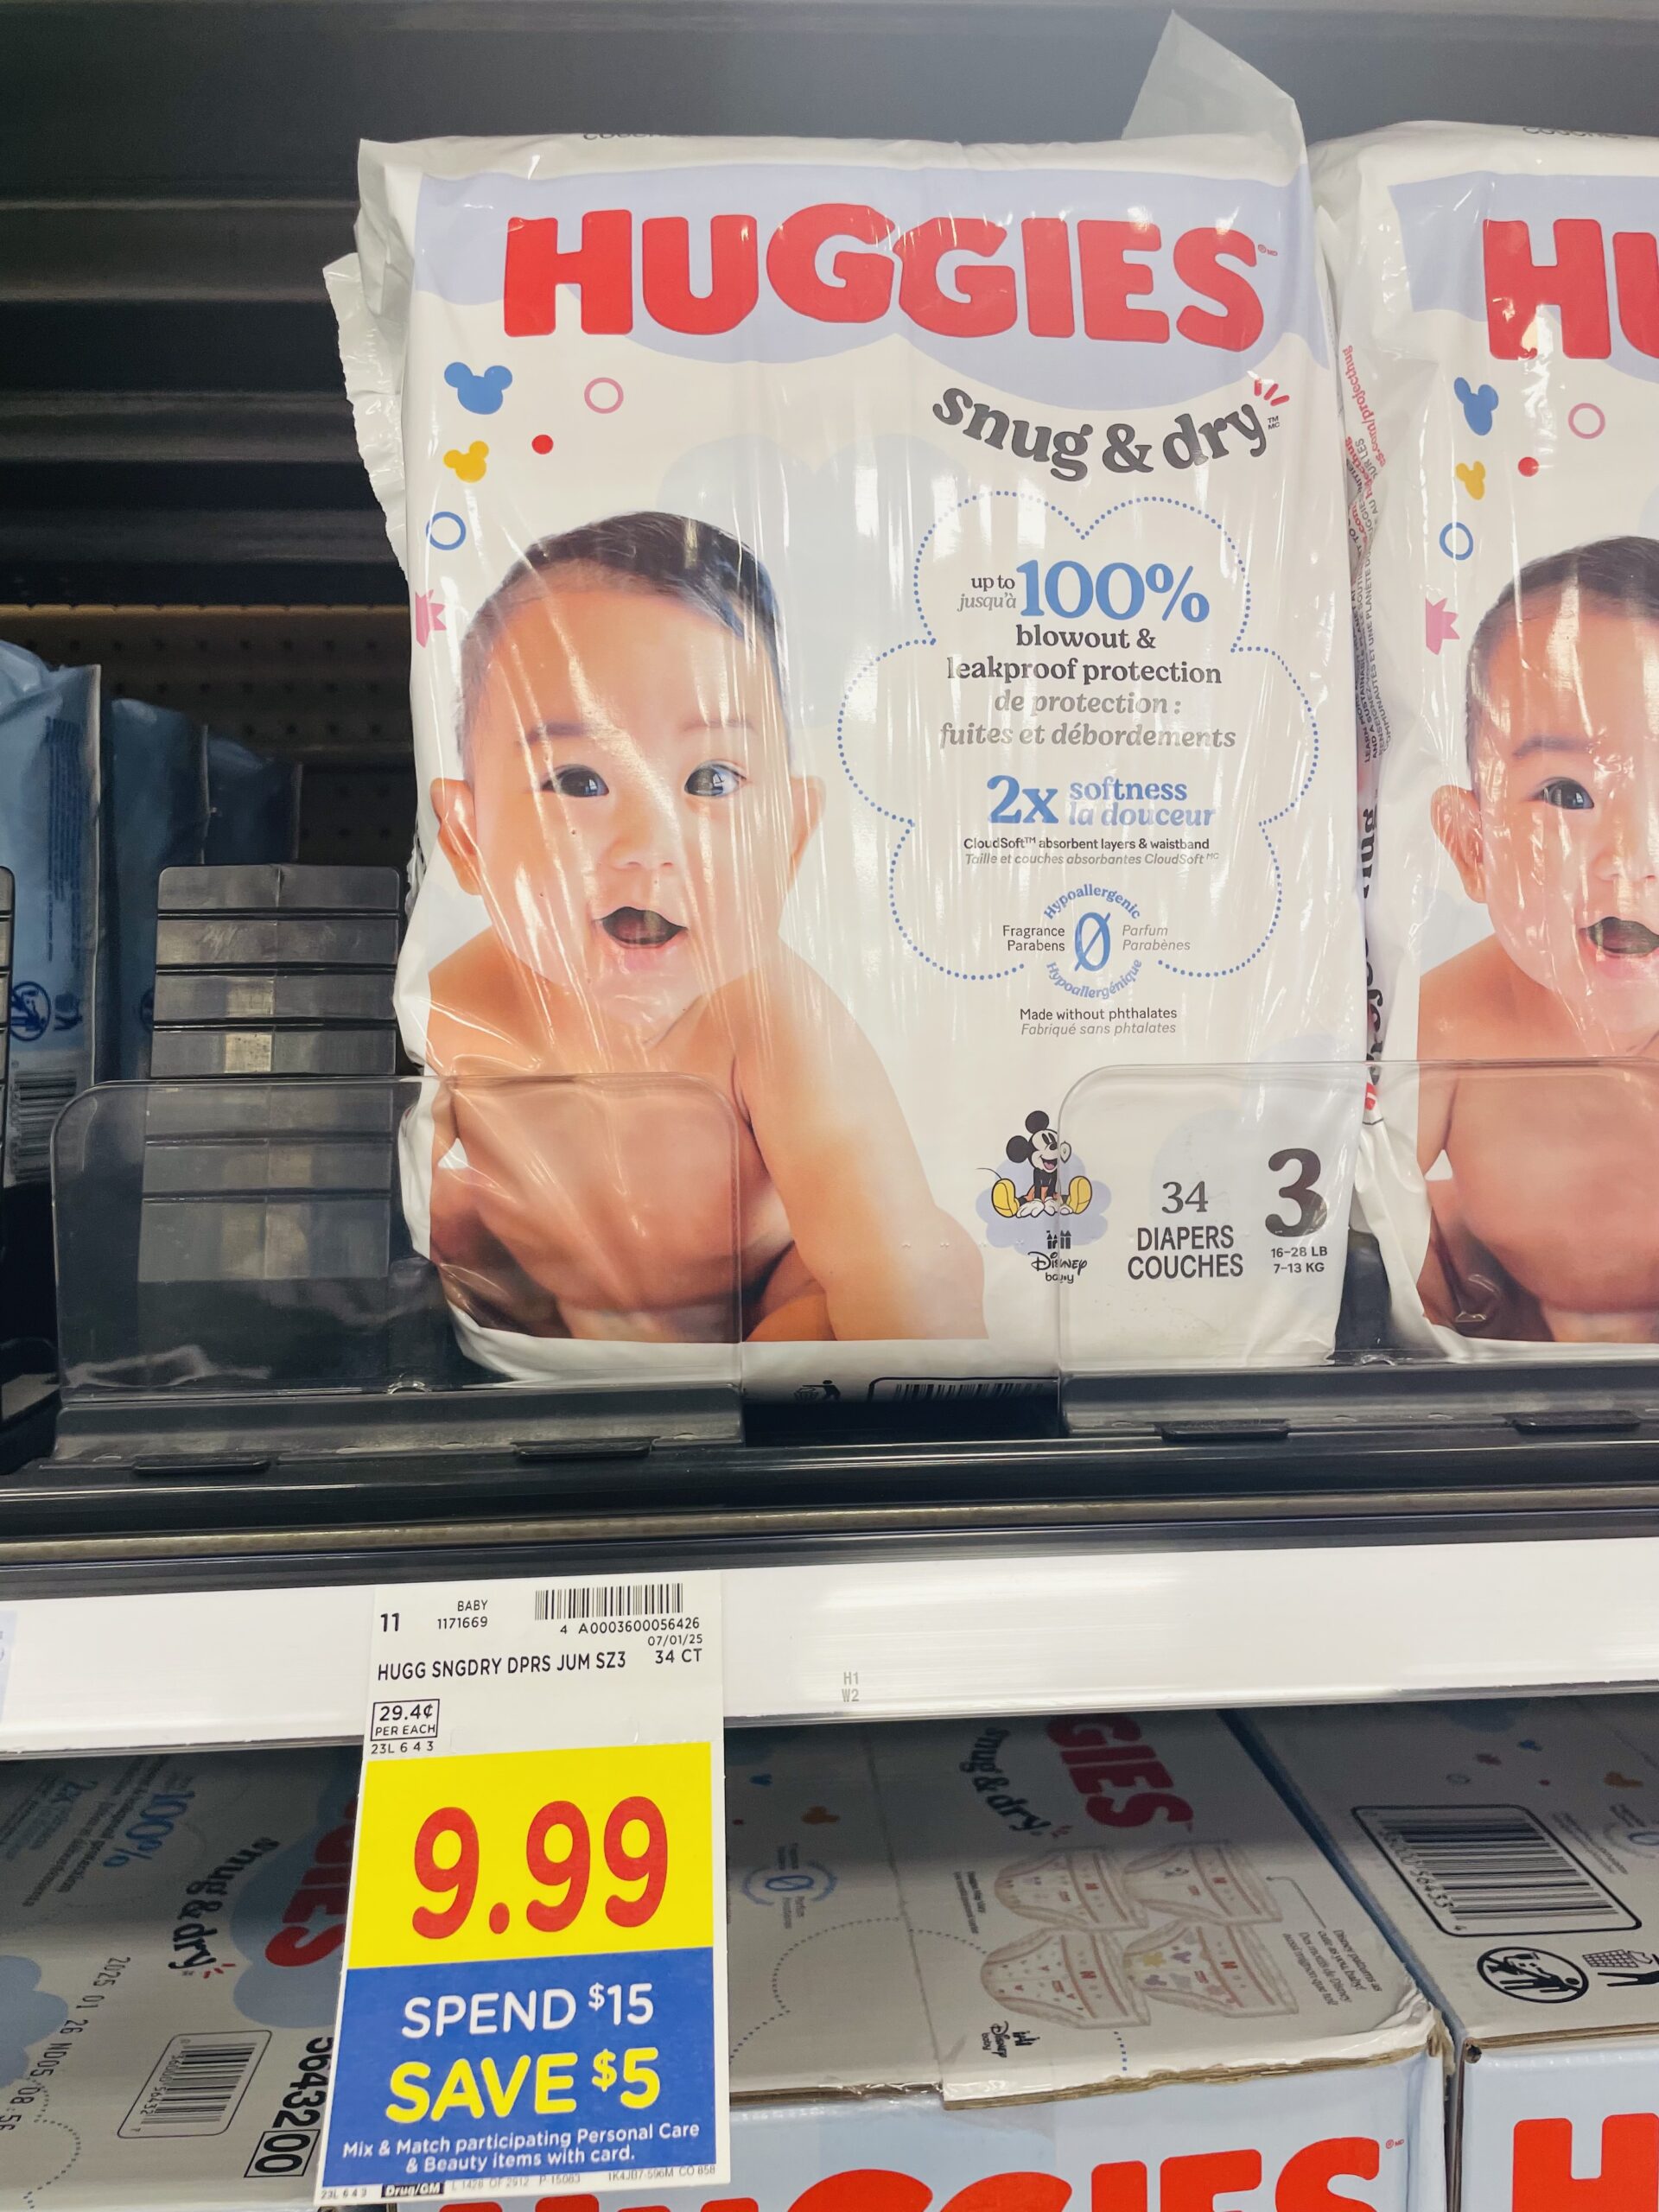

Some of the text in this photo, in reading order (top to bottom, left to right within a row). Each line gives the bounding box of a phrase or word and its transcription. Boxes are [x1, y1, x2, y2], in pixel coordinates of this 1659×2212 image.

[504, 202, 1264, 353] HUGGIES
[932, 387, 1268, 481] snug & dry
[971, 575, 1015, 591] up to
[1016, 560, 1210, 623] 100%
[1016, 624, 1157, 649] blowout &
[947, 656, 1223, 684] leakproof protection
[995, 690, 1025, 712] de
[1031, 692, 1168, 716] protection
[940, 722, 1236, 749] fuites et débordements
[987, 775, 1059, 824] 2x
[1069, 776, 1188, 801] softness
[1069, 802, 1216, 826] la douceur
[1039, 838, 1098, 850] absorbent
[1101, 838, 1135, 852] layers
[1139, 838, 1147, 849] &
[1150, 838, 1210, 850] waistband
[965, 853, 998, 865] Taille
[1000, 854, 1013, 864] et
[1015, 853, 1064, 865] couches
[1066, 853, 1141, 865] absorbantes
[1043, 883, 1141, 920] Hypoallergenic
[1002, 925, 1065, 938] Fragrance
[1122, 925, 1168, 938] Parfum
[1007, 939, 1065, 951] Parabens
[1122, 938, 1191, 951] Parabènes
[1046, 958, 1142, 1000] Hypoallergénique
[1020, 1007, 1178, 1023] Made without phthalates
[1021, 1022, 1176, 1037] Fabriqué sans phtalates
[1161, 1181, 1209, 1214] 34
[1265, 1147, 1328, 1238] 3
[1137, 1224, 1235, 1251] DIAPERS
[1311, 1245, 1328, 1257] LB
[1128, 1253, 1243, 1280] COUCHES
[1306, 1262, 1325, 1273] KG
[457, 1599, 488, 1611] BABY
[380, 1612, 401, 1632] 11
[437, 1616, 488, 1630] 1171669
[560, 1618, 700, 1635] 4 A0003600056426
[647, 1634, 703, 1647] 07/01/25
[378, 1651, 626, 1681] HUGG SNGDRY DPRS JUM SZ3
[654, 1648, 702, 1664] 34 CT
[843, 1671, 859, 1685] H1
[841, 1688, 860, 1702] W2
[378, 1704, 434, 1722] 29.4¢
[375, 1723, 436, 1737] PER EACH
[371, 1740, 434, 1755] 23L 6 4 3
[186, 1837, 280, 1896] snug
[412, 1796, 668, 1940] 9.99
[168, 1923, 218, 1969] dry
[93, 1957, 130, 1986] 2025
[76, 1994, 105, 2009] 01
[402, 1982, 654, 2038] SPEND $15
[60, 2019, 89, 2034] 26
[385, 2047, 660, 2123] SAVE $5
[343, 2122, 700, 2158] Mix & Match participating Personal Care
[405, 2145, 635, 2174] & Beauty items with card.
[385, 2182, 441, 2196] Drug/GM
